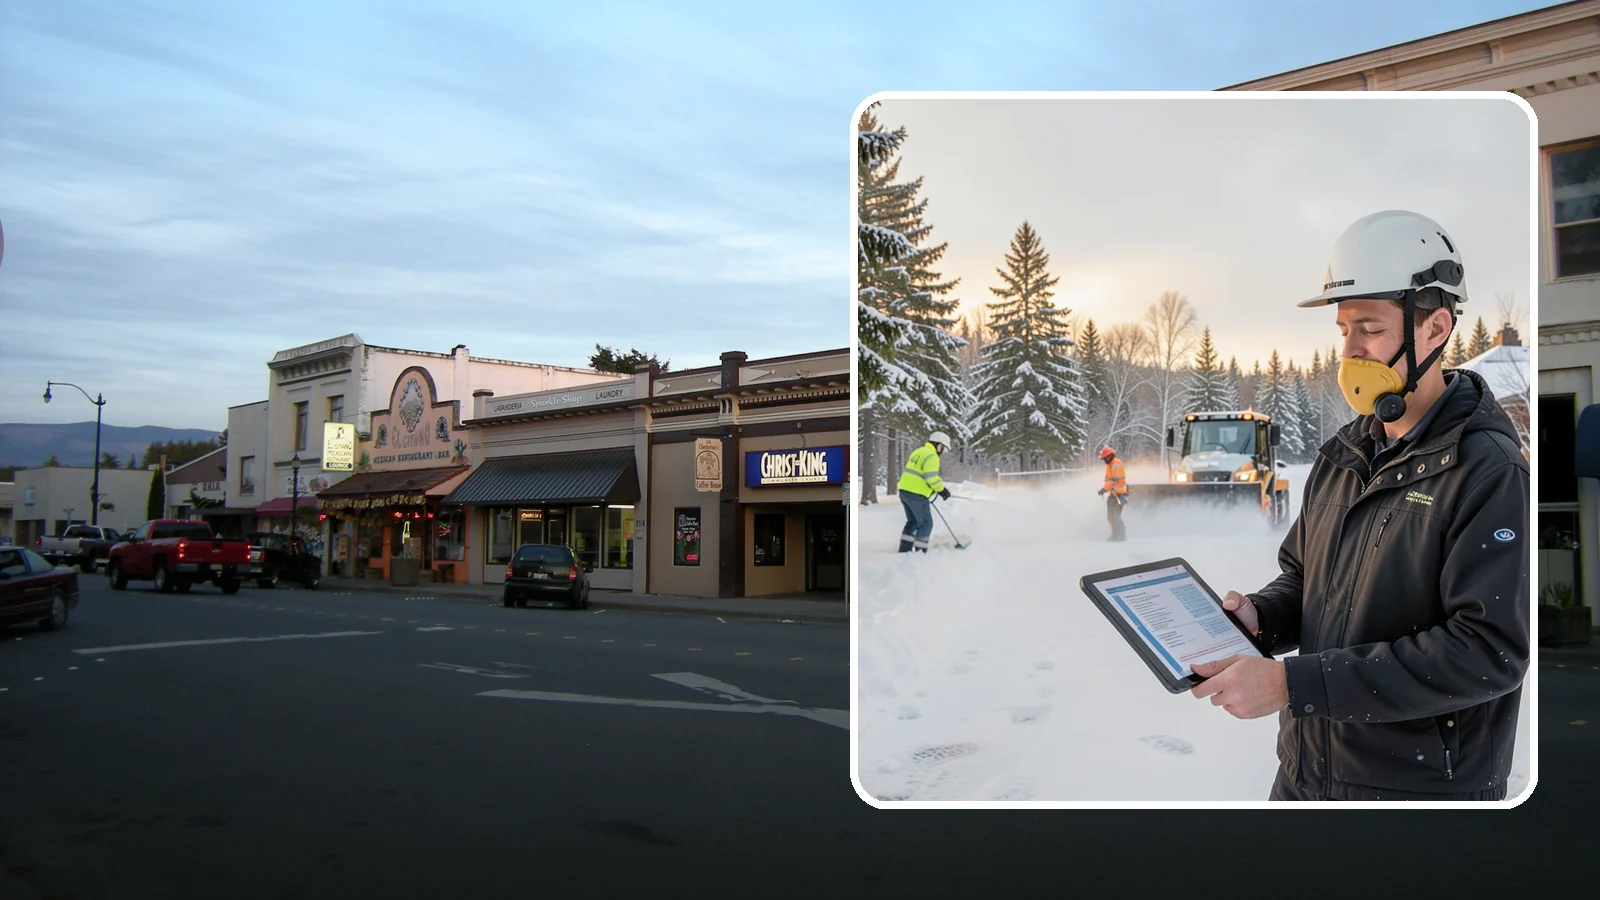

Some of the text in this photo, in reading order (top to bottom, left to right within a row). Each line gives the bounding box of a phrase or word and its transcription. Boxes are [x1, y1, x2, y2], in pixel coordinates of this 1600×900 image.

[531, 394, 582, 409] Sparkle Shop
[595, 389, 623, 400] LAUNDRY
[493, 402, 522, 412] LAVANDERIA
[373, 450, 449, 464] MEXICAN RESTAURANT BAR
[761, 450, 827, 477] CHRIST KING
